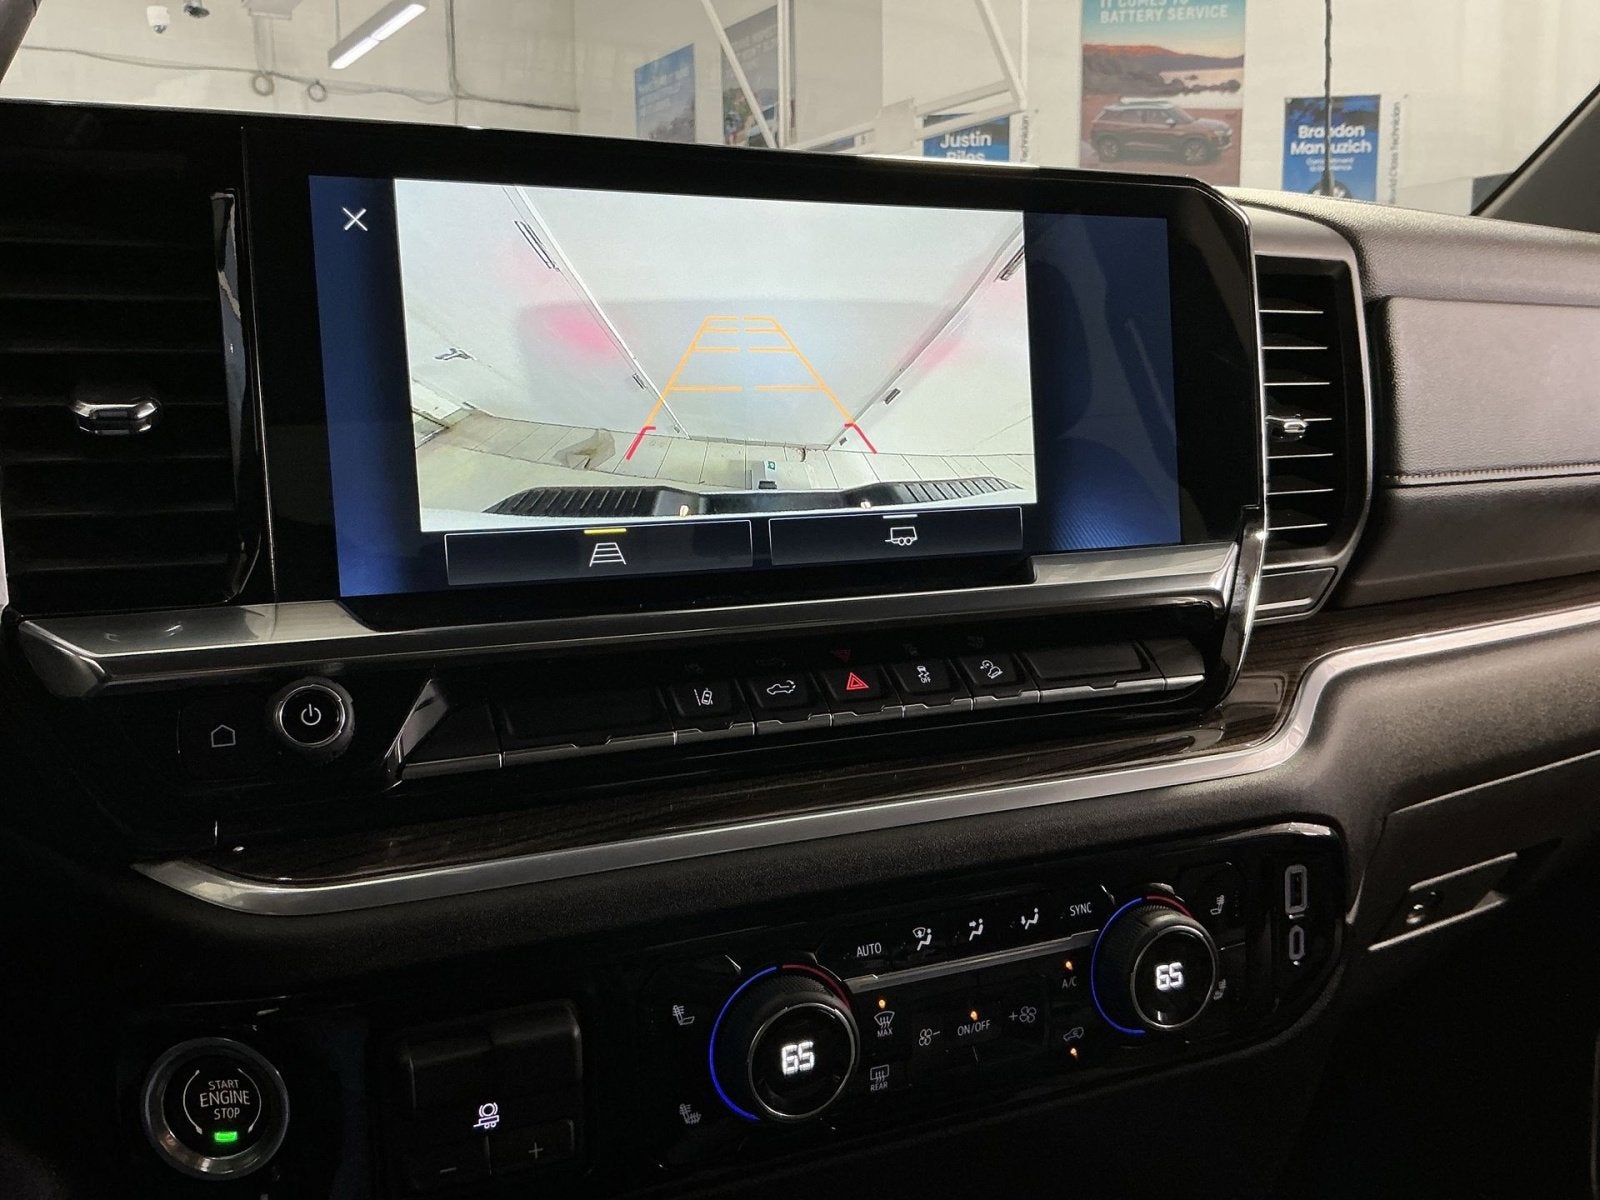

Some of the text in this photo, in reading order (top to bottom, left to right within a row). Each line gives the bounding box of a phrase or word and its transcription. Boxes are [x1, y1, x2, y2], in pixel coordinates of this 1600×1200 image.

[1101, 4, 1229, 24] BATTERY SERVICE
[1298, 123, 1365, 139] Bradon
[940, 131, 992, 148] Justin
[1069, 901, 1092, 917] SYNC
[856, 942, 882, 957] AUTO
[1061, 975, 1078, 989] A/C
[1156, 961, 1184, 991] 65
[876, 1026, 893, 1037] MAX
[957, 1019, 991, 1036] ON/OFF
[781, 1040, 815, 1076] 65
[208, 1079, 239, 1091] START
[870, 1081, 888, 1092] REAR
[199, 1090, 251, 1108] ENGINE
[213, 1107, 241, 1120] STOP
